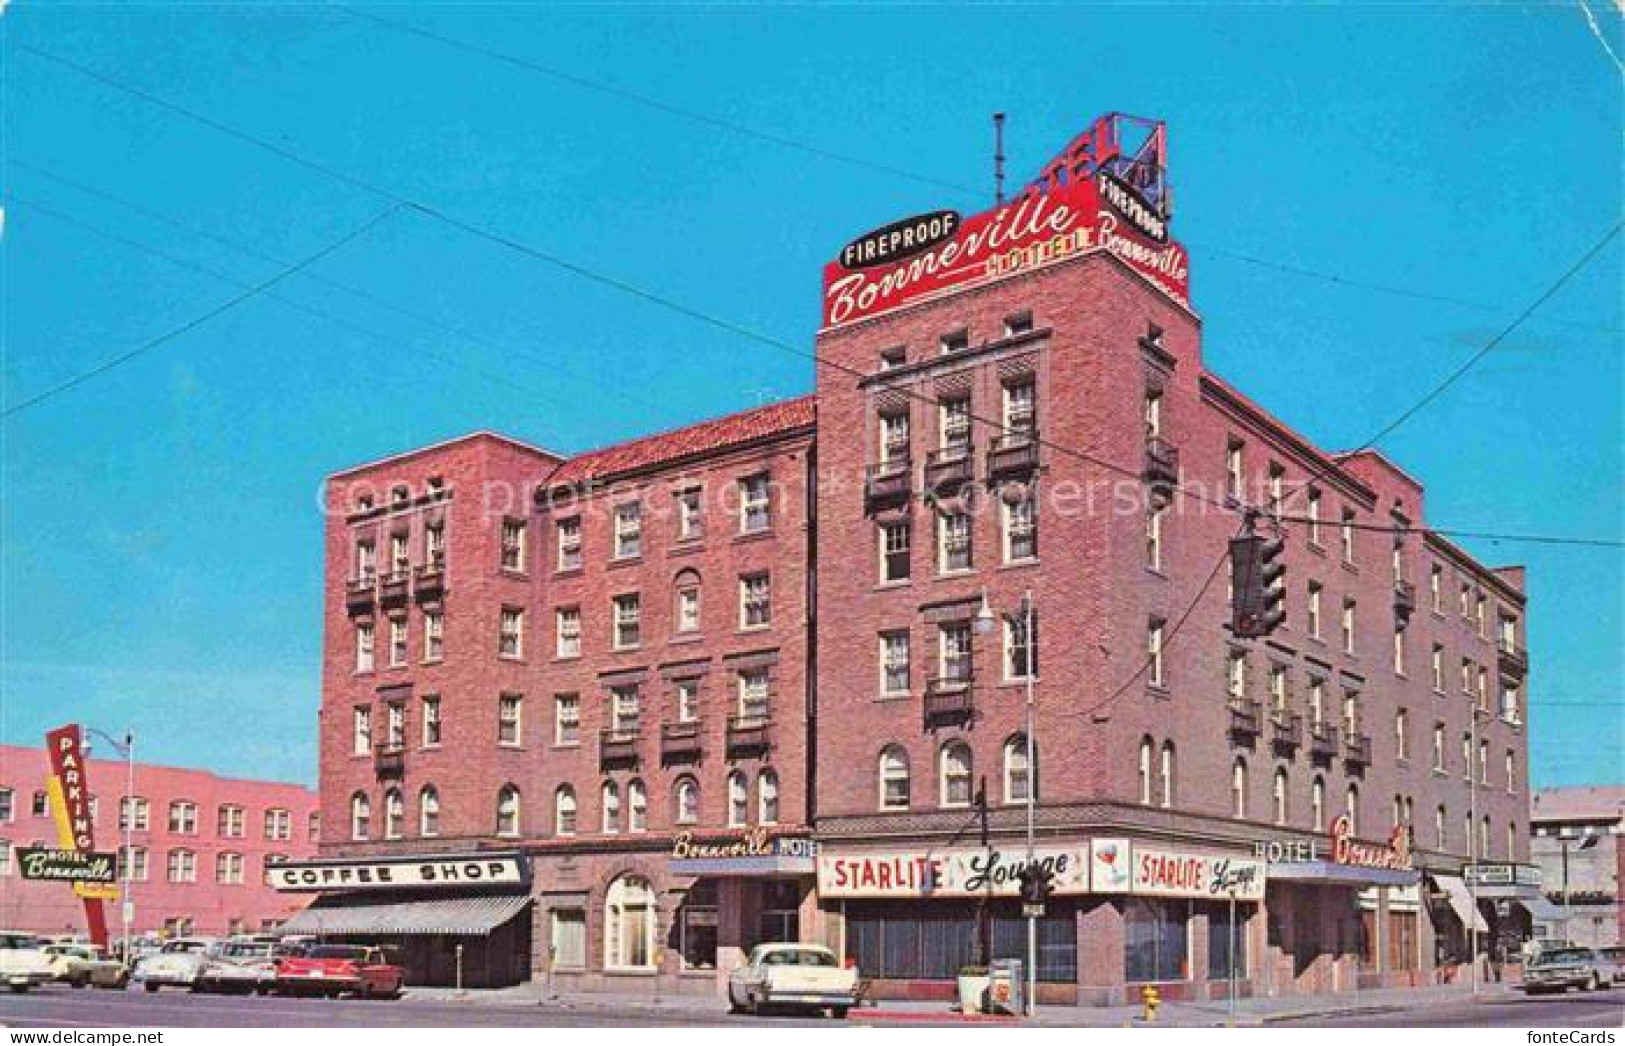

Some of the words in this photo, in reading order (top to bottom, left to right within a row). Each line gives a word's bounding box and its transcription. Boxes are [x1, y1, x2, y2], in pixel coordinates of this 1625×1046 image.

[826, 193, 1079, 325] Bonneville
[843, 212, 955, 267] FIREPROOF
[985, 225, 1095, 277] HOTEL
[1097, 209, 1187, 279] Bonneville
[59, 736, 92, 849] PARKING
[282, 866, 393, 885] COFFEE
[419, 862, 506, 881] SHOP
[835, 857, 943, 890] STARLITE
[1141, 853, 1204, 890] STARLITE
[1255, 839, 1320, 863] HOTEL
